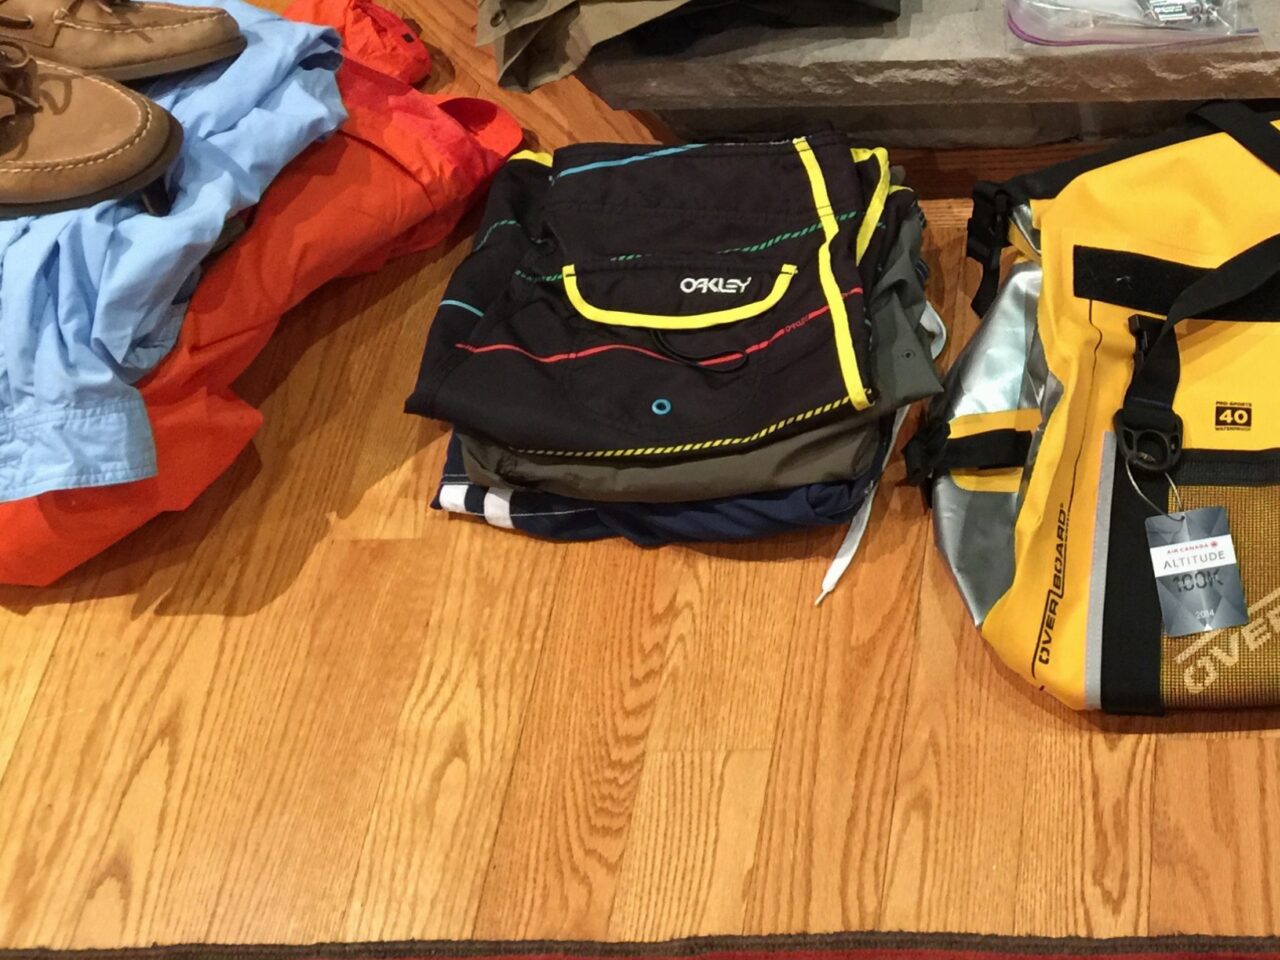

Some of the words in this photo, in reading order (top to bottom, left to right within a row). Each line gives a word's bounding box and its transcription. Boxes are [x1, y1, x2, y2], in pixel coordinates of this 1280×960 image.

[680, 276, 752, 293] OAKLEY
[1219, 409, 1249, 424] 40
[1180, 543, 1209, 553] CANADA
[1163, 550, 1226, 570] ALTITUDE
[1172, 568, 1224, 593] 100K
